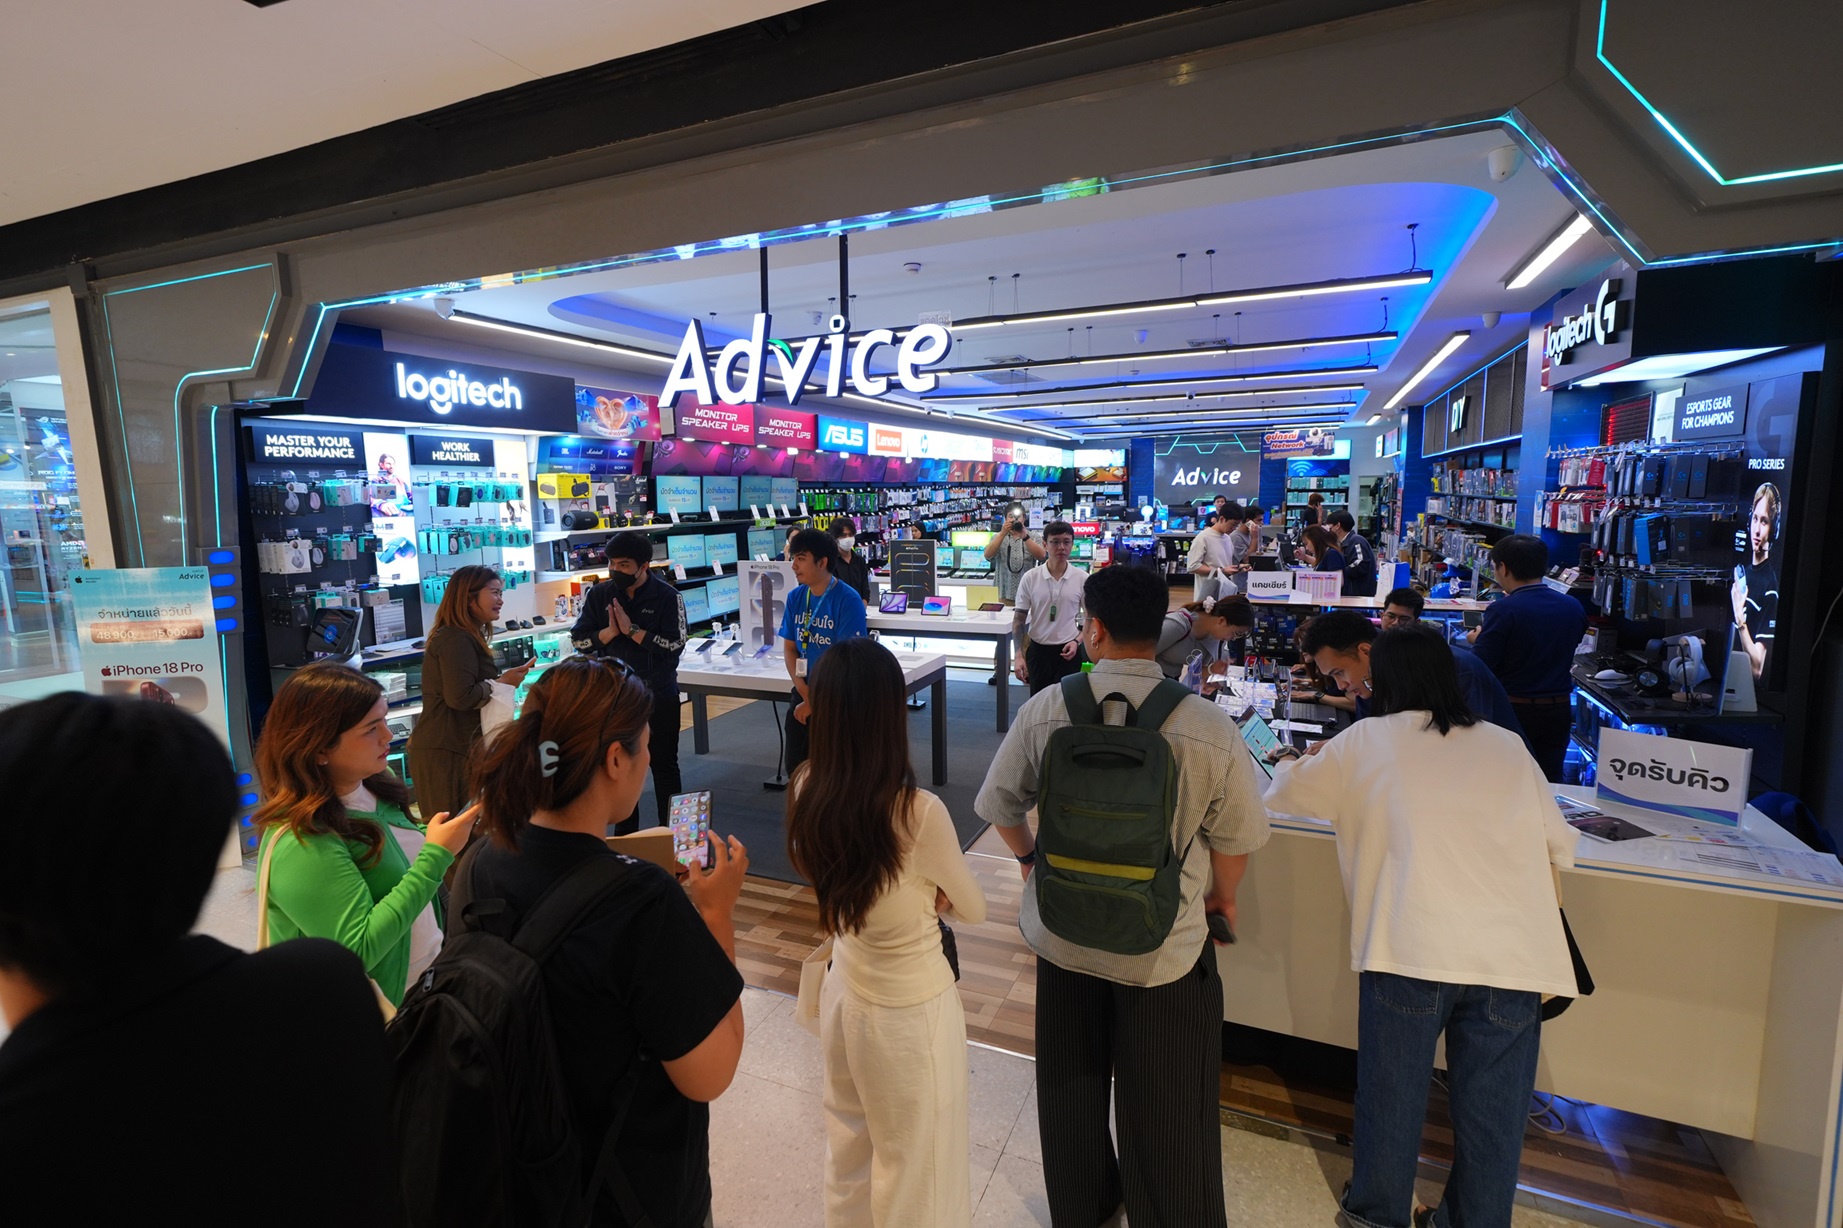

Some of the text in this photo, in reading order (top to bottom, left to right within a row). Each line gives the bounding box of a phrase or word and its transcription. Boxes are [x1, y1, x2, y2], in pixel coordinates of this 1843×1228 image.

[1545, 278, 1618, 366] logitech G
[657, 312, 952, 408] Advice
[395, 362, 522, 415] logitech
[1686, 395, 1732, 415] ESPORTS GEAR
[694, 407, 738, 422] MONITOR
[1681, 416, 1694, 430] FOR
[1694, 410, 1735, 428] CHAMPIONS
[681, 416, 750, 433] SPEAKER UPS
[768, 418, 802, 430] MONITOR
[758, 426, 811, 440] SPEAKER UPS
[824, 424, 864, 447] ASUS
[876, 432, 901, 449] Lenovo
[266, 434, 352, 448] MASTER YOUR
[441, 441, 471, 452] WORK
[1270, 440, 1305, 449] Network
[264, 446, 355, 459] PERFORMANCE
[432, 450, 480, 462] HEALTHIER
[1748, 458, 1785, 470] PRO SERIES
[1171, 466, 1242, 486] Advice
[1252, 580, 1287, 589] แคชเชียร์
[97, 603, 193, 619] จำหน่ายแล้ววันนี้
[808, 633, 832, 645] Mac
[113, 661, 204, 676] iPhone 18 Pro
[1609, 758, 1730, 793] จุดรับคิว
